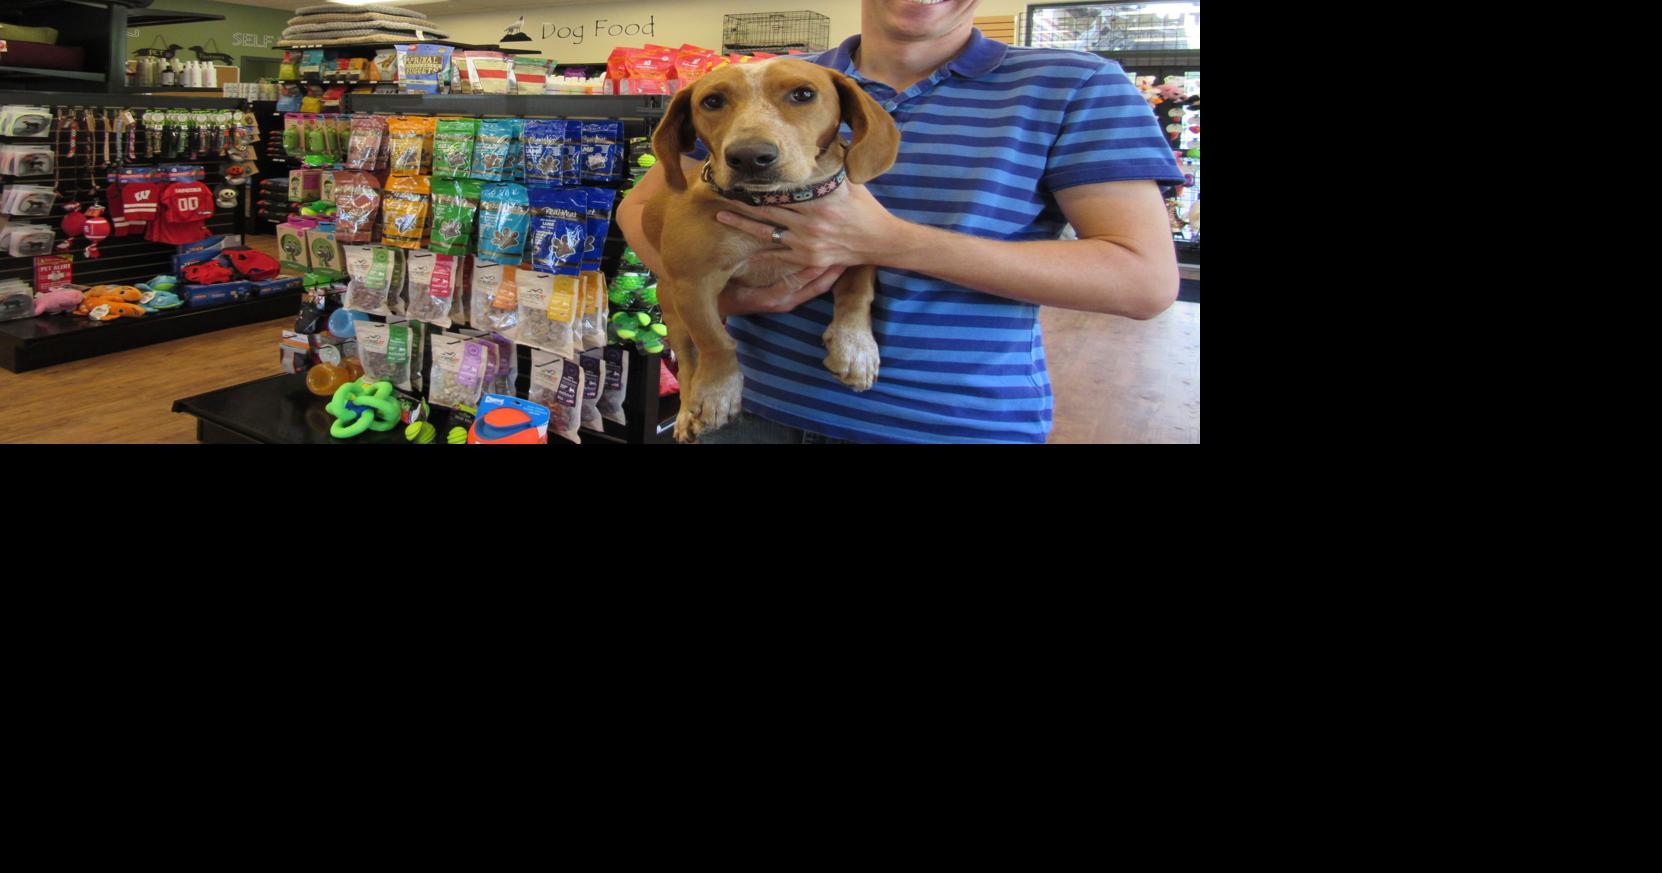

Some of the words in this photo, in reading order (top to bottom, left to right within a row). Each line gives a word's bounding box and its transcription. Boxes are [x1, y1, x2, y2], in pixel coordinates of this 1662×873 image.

[541, 23, 584, 45] Dog
[595, 15, 655, 37] Food
[232, 32, 274, 48] SELF
[134, 190, 151, 201] W
[177, 197, 199, 212] 00
